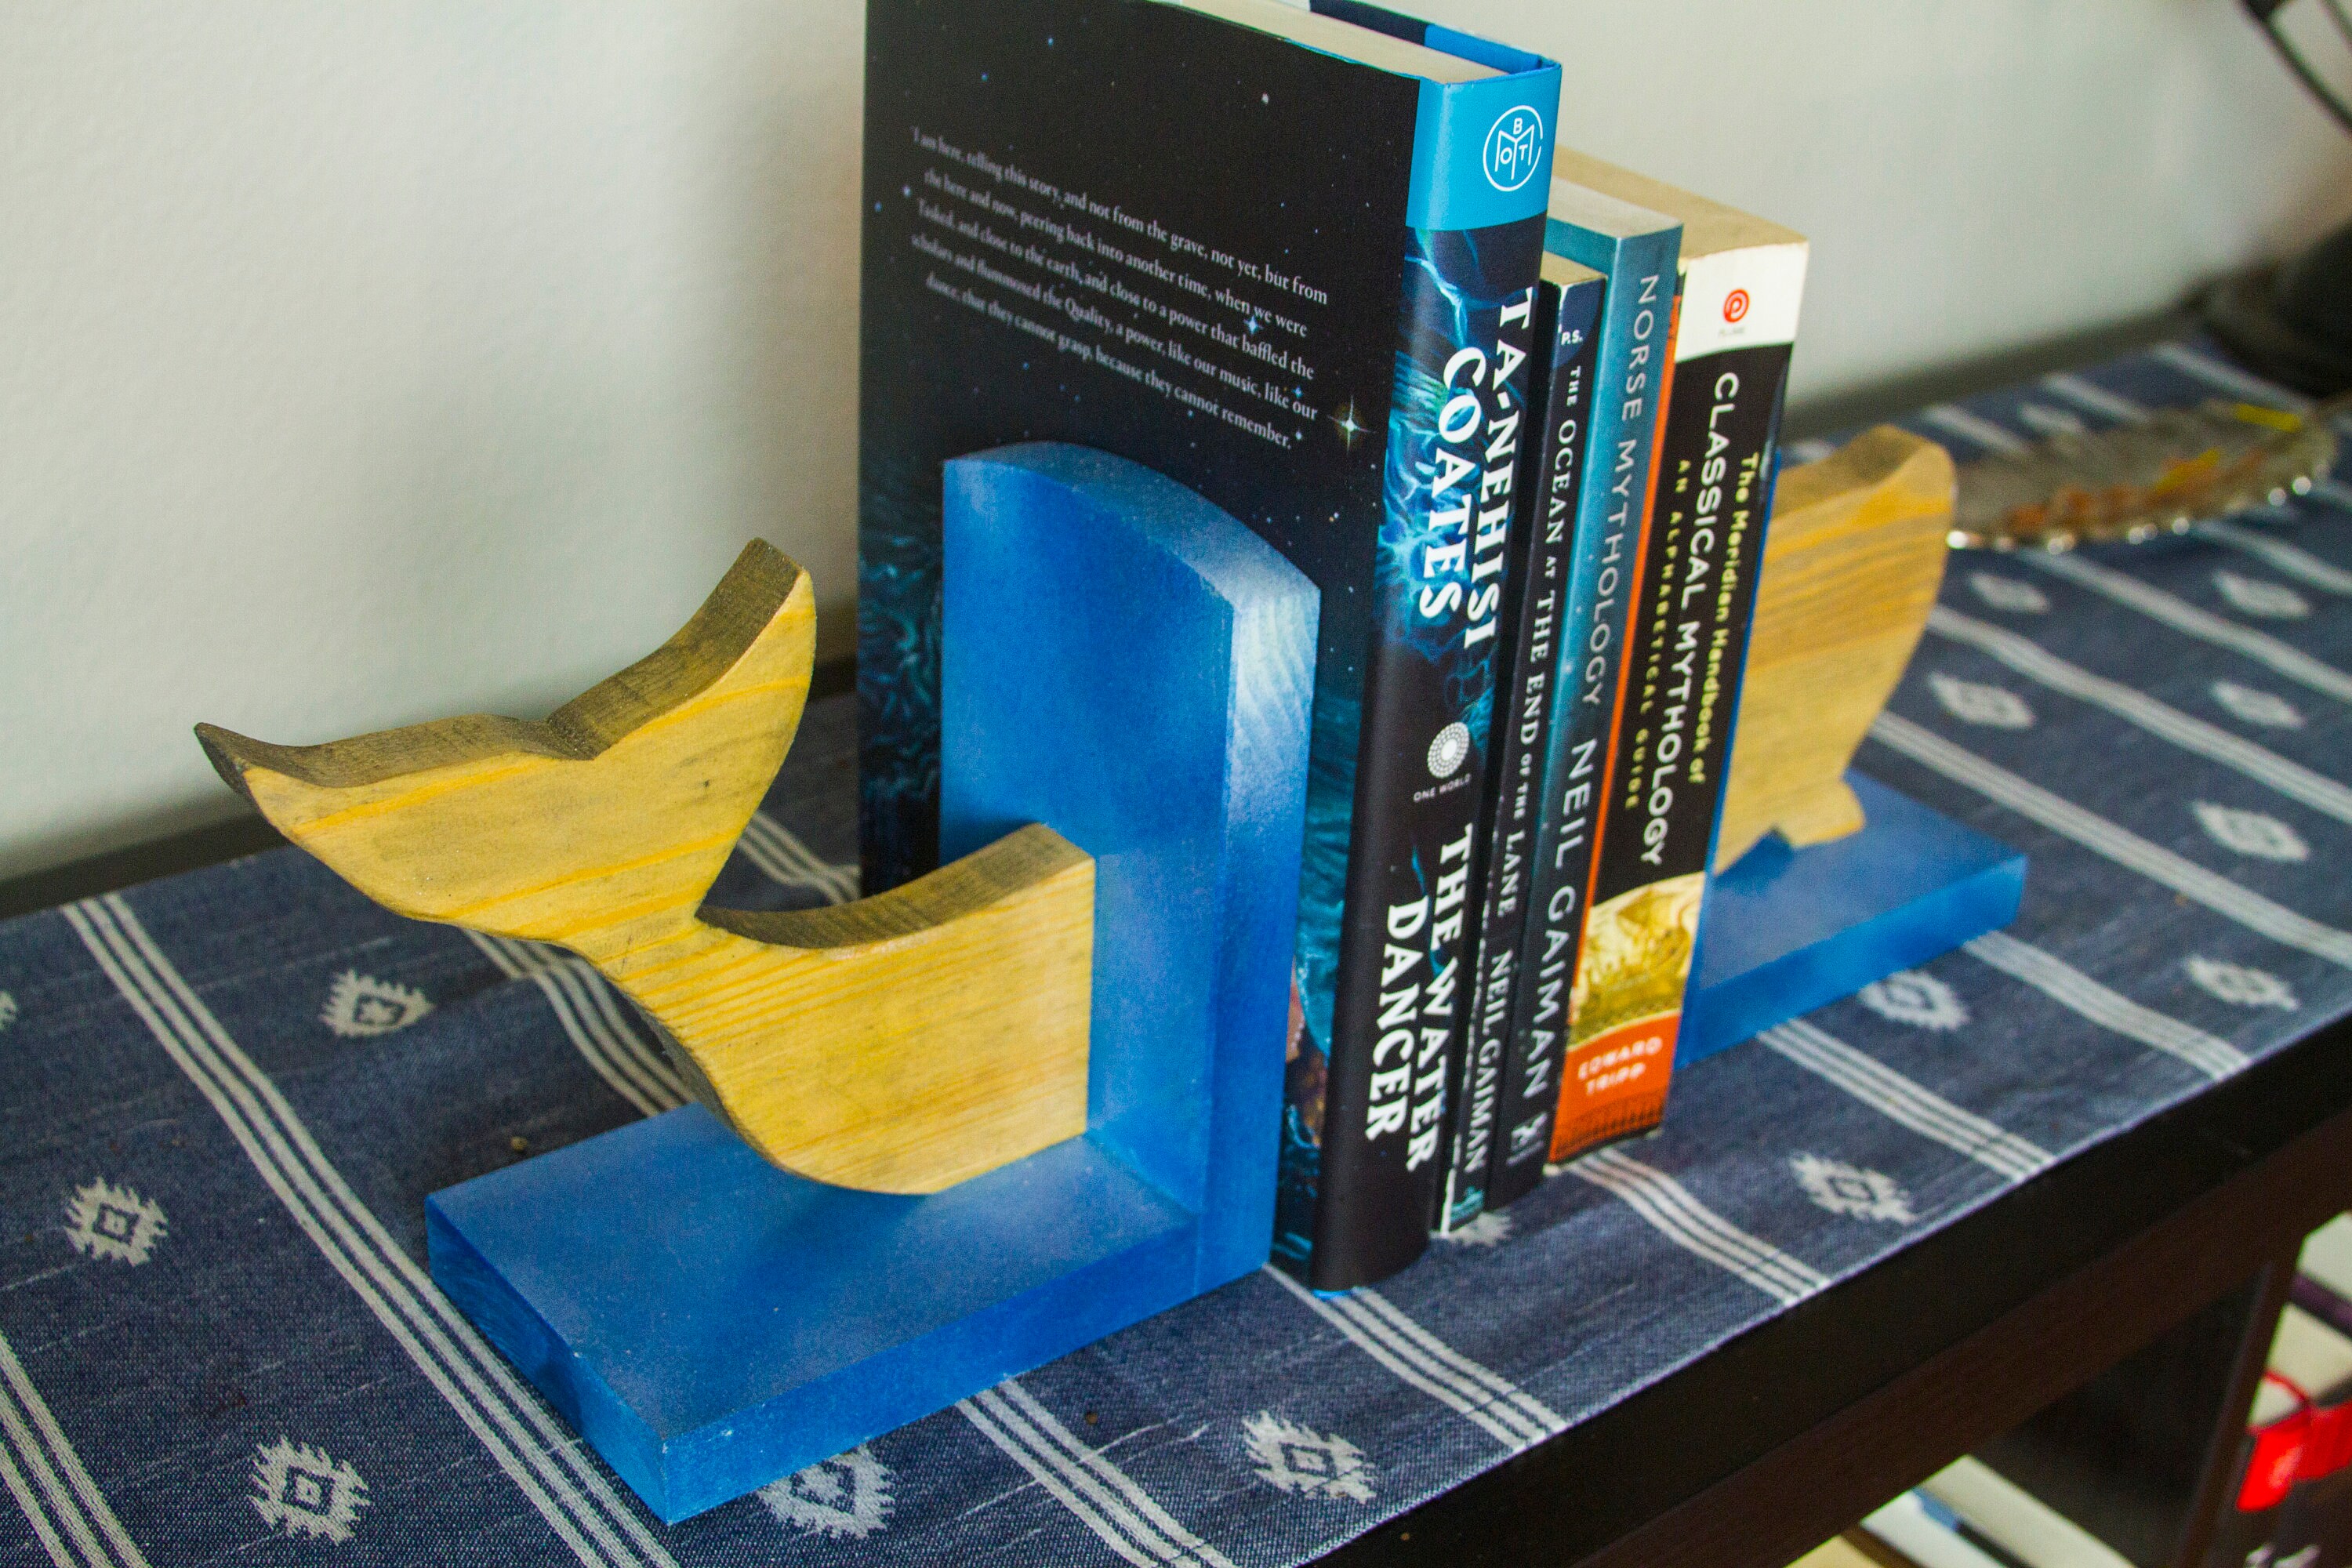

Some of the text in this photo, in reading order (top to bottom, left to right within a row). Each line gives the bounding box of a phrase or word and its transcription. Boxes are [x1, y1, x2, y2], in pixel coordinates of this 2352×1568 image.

[921, 134, 937, 149] am
[967, 151, 1003, 183] telling
[1004, 164, 1027, 187] this
[1063, 192, 1087, 211] and
[1089, 201, 1110, 220] not
[1113, 205, 1144, 233] from
[1148, 220, 1168, 242] the
[1171, 234, 1208, 260] grave,
[1211, 249, 1235, 269] not
[1238, 260, 1261, 281] yet,
[1265, 263, 1289, 290] but
[1293, 276, 1328, 305] from
[924, 167, 941, 188] the
[943, 173, 967, 198] here
[969, 191, 990, 209] and
[1020, 211, 1065, 245] peering
[1066, 223, 1094, 251] back
[1098, 237, 1124, 263] into
[1126, 254, 1176, 283] another
[1178, 274, 1211, 300] time,
[1215, 289, 1250, 314] when
[1254, 306, 1272, 323] we
[1275, 314, 1308, 338] were
[958, 221, 979, 238] and
[1010, 241, 1024, 258] to
[1025, 245, 1044, 266] the
[1047, 258, 1083, 285] earth,
[1085, 274, 1108, 293] and
[1110, 281, 1141, 307] close
[1143, 297, 1157, 313] to
[1160, 305, 1167, 318] a
[1169, 309, 1207, 335] power
[1210, 323, 1240, 348] that
[1242, 334, 1287, 368] baffled
[1290, 357, 1315, 379] the
[954, 255, 976, 273] and
[1043, 284, 1062, 310] the
[1065, 297, 1114, 335] Quality,
[1116, 324, 1123, 336] a
[1125, 327, 1165, 356] power,
[1168, 339, 1192, 366] like
[1193, 358, 1216, 377] our
[1220, 368, 1261, 398] music,
[1265, 382, 1289, 408] like
[1293, 401, 1318, 420] our
[988, 300, 1013, 327] they
[1014, 315, 1055, 343] cannot
[1096, 345, 1142, 381] because
[1145, 369, 1172, 398] they
[1174, 387, 1219, 416] cannot
[1221, 408, 1291, 450] remember.
[1561, 329, 1583, 345] P.S.
[1566, 365, 1581, 406] THE
[1419, 347, 1486, 618] COATES
[1464, 287, 1533, 649] TA-NEHISI
[1545, 419, 1576, 543] OCEAN
[1583, 275, 1658, 705] NORSE MYTHOLOGY
[1675, 460, 1691, 494] AN
[1682, 372, 1740, 610] CLASSICAL
[1530, 590, 1555, 662] THE
[1545, 556, 1556, 579] AT
[1640, 511, 1682, 714] ALPHABETICAL
[1688, 451, 1759, 784] The Meridian Handbook of
[1414, 773, 1471, 803] ONE WORLD
[1520, 672, 1544, 745] END
[1641, 621, 1700, 865] MYTHOLOGY
[1497, 829, 1525, 917] LANE
[1514, 782, 1528, 820] THE
[1406, 822, 1473, 1171] THE WATER
[1523, 739, 1597, 1098] NEIL GAIMAN
[1366, 895, 1429, 1140] DANCER
[1465, 949, 1513, 1173] NEIL GAIMAN
